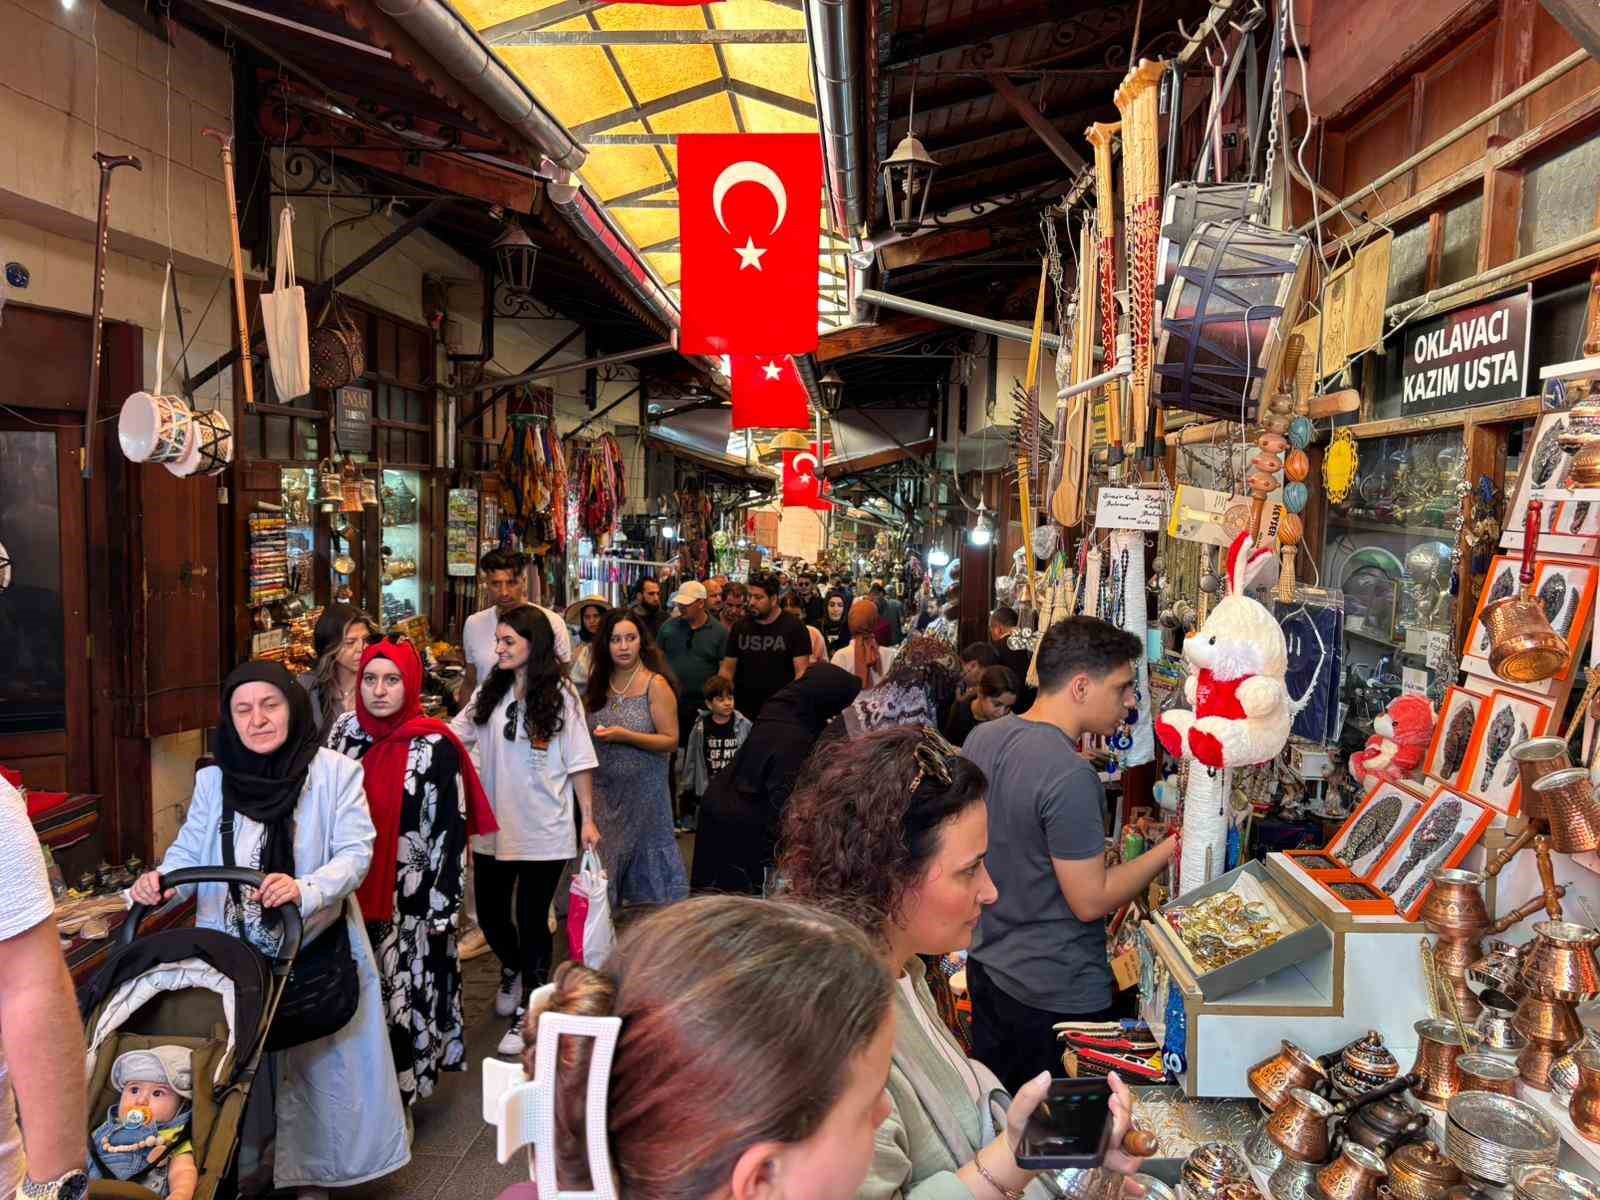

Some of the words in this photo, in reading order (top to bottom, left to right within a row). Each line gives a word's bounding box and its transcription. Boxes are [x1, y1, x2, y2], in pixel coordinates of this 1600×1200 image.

[1414, 309, 1509, 364] OKLAVACI
[1403, 363, 1460, 404] KAZIM
[1464, 350, 1518, 391] USTA
[738, 633, 786, 651] USPA
[708, 739, 721, 748] GET
[723, 749, 736, 759] MY
